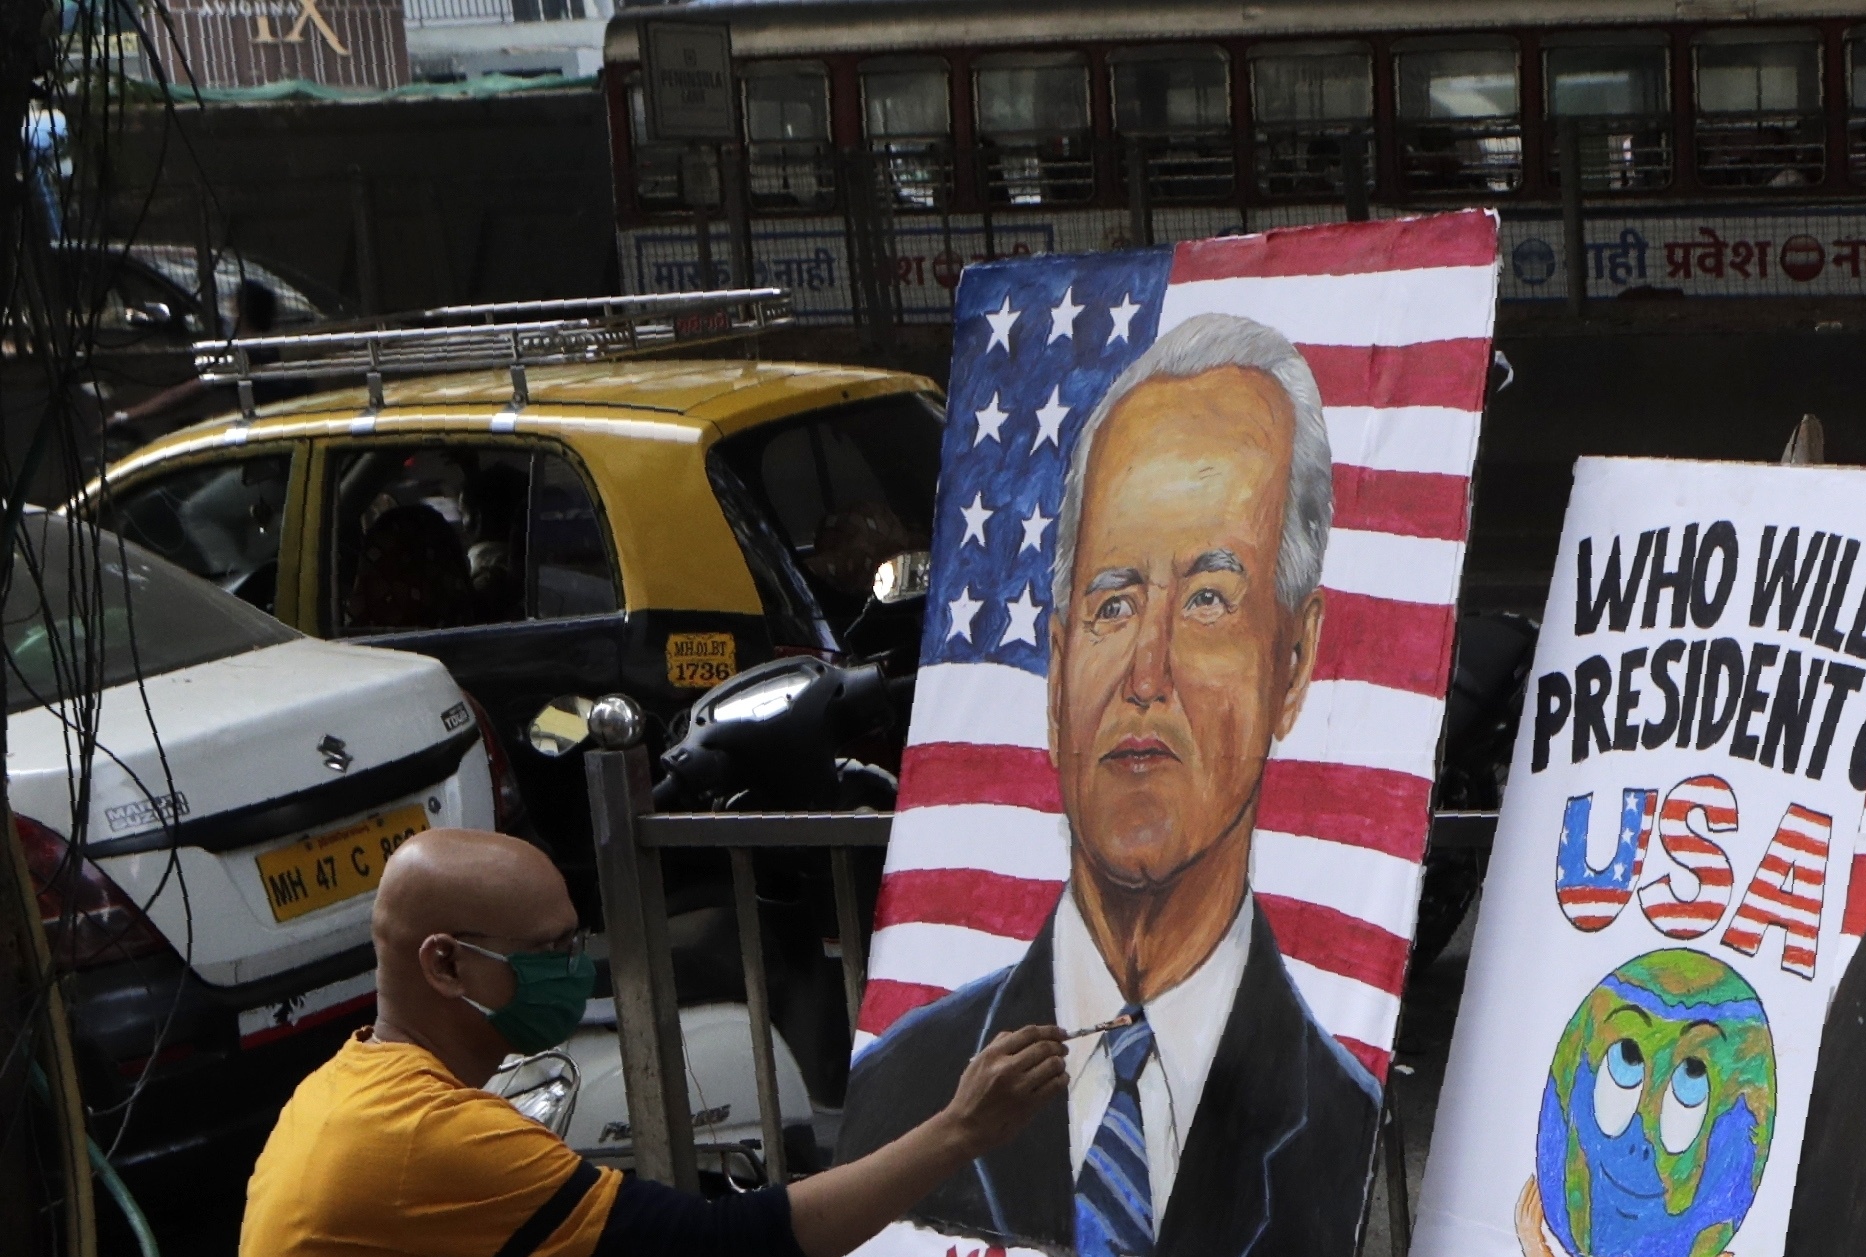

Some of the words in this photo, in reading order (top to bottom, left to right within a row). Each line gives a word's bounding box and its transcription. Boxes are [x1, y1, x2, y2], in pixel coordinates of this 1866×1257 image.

[772, 246, 836, 291] नाही
[1563, 226, 1649, 285] ाही
[1663, 226, 1772, 279] प्रवेश
[1573, 519, 1740, 637] WHO
[675, 662, 730, 681] 1736
[1530, 637, 1866, 782] PRESIDENT
[268, 868, 310, 907] MH
[315, 855, 339, 891] 47
[350, 846, 371, 878] C
[1553, 773, 1834, 982] USA
